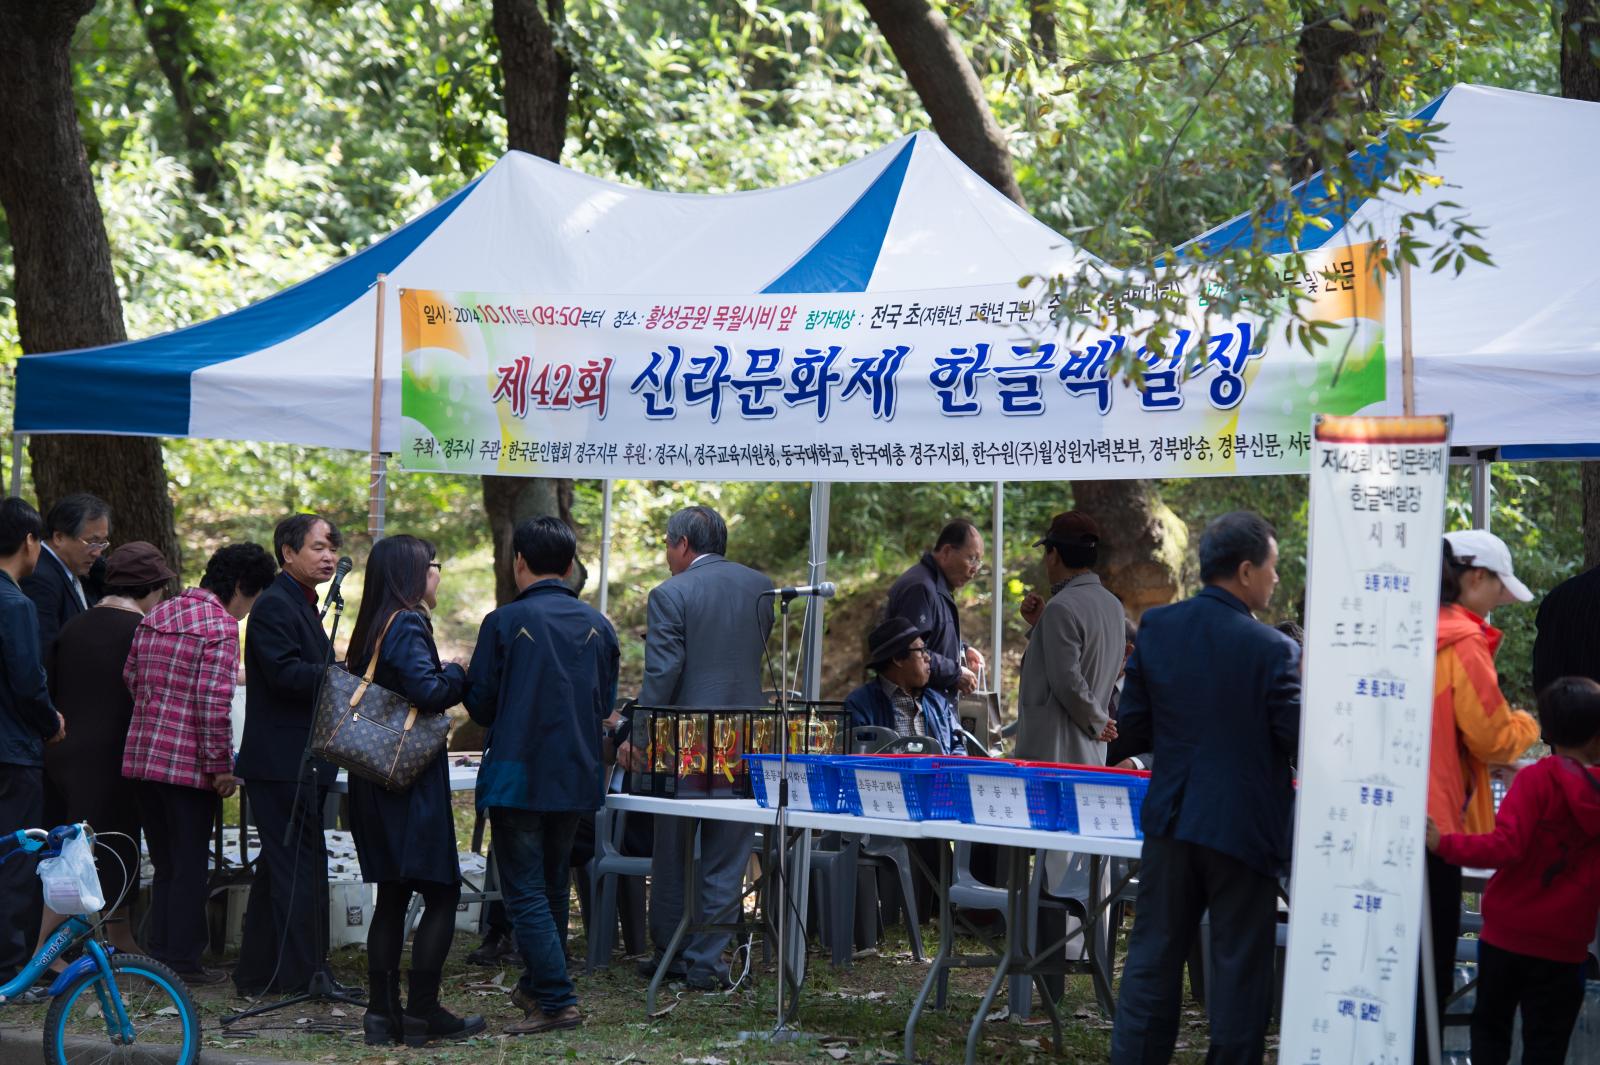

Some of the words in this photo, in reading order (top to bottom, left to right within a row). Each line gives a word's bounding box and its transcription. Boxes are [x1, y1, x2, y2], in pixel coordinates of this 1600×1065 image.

[645, 305, 712, 330] 황성공원
[712, 305, 778, 331] 목월시비
[777, 305, 797, 332] 앞
[804, 309, 855, 330] 참가대상
[870, 303, 903, 329] 전국
[903, 303, 962, 327] 초(저학년,
[966, 301, 1004, 323] 고학년
[1005, 300, 1035, 322] 구분)
[492, 355, 615, 417] 제42회
[629, 344, 912, 420] 신라문화제
[929, 322, 1263, 413] 한글백일장
[443, 438, 475, 460] 경주시
[508, 440, 572, 463] 한국문인협회
[573, 441, 618, 465] 경주지부
[654, 443, 692, 467] 경주시,
[693, 443, 780, 467] 경주교육지원청,
[781, 442, 849, 468] 동국대학교,
[850, 442, 906, 467] 한국예총
[909, 441, 969, 468] 경주지회,
[971, 437, 1145, 466] 한수원(주)월성원자력본부,
[1149, 434, 1214, 462] 경북방송,
[1218, 432, 1284, 460] 경북신문,
[1321, 448, 1372, 473] 제42회
[1351, 484, 1421, 512] 한글백일장
